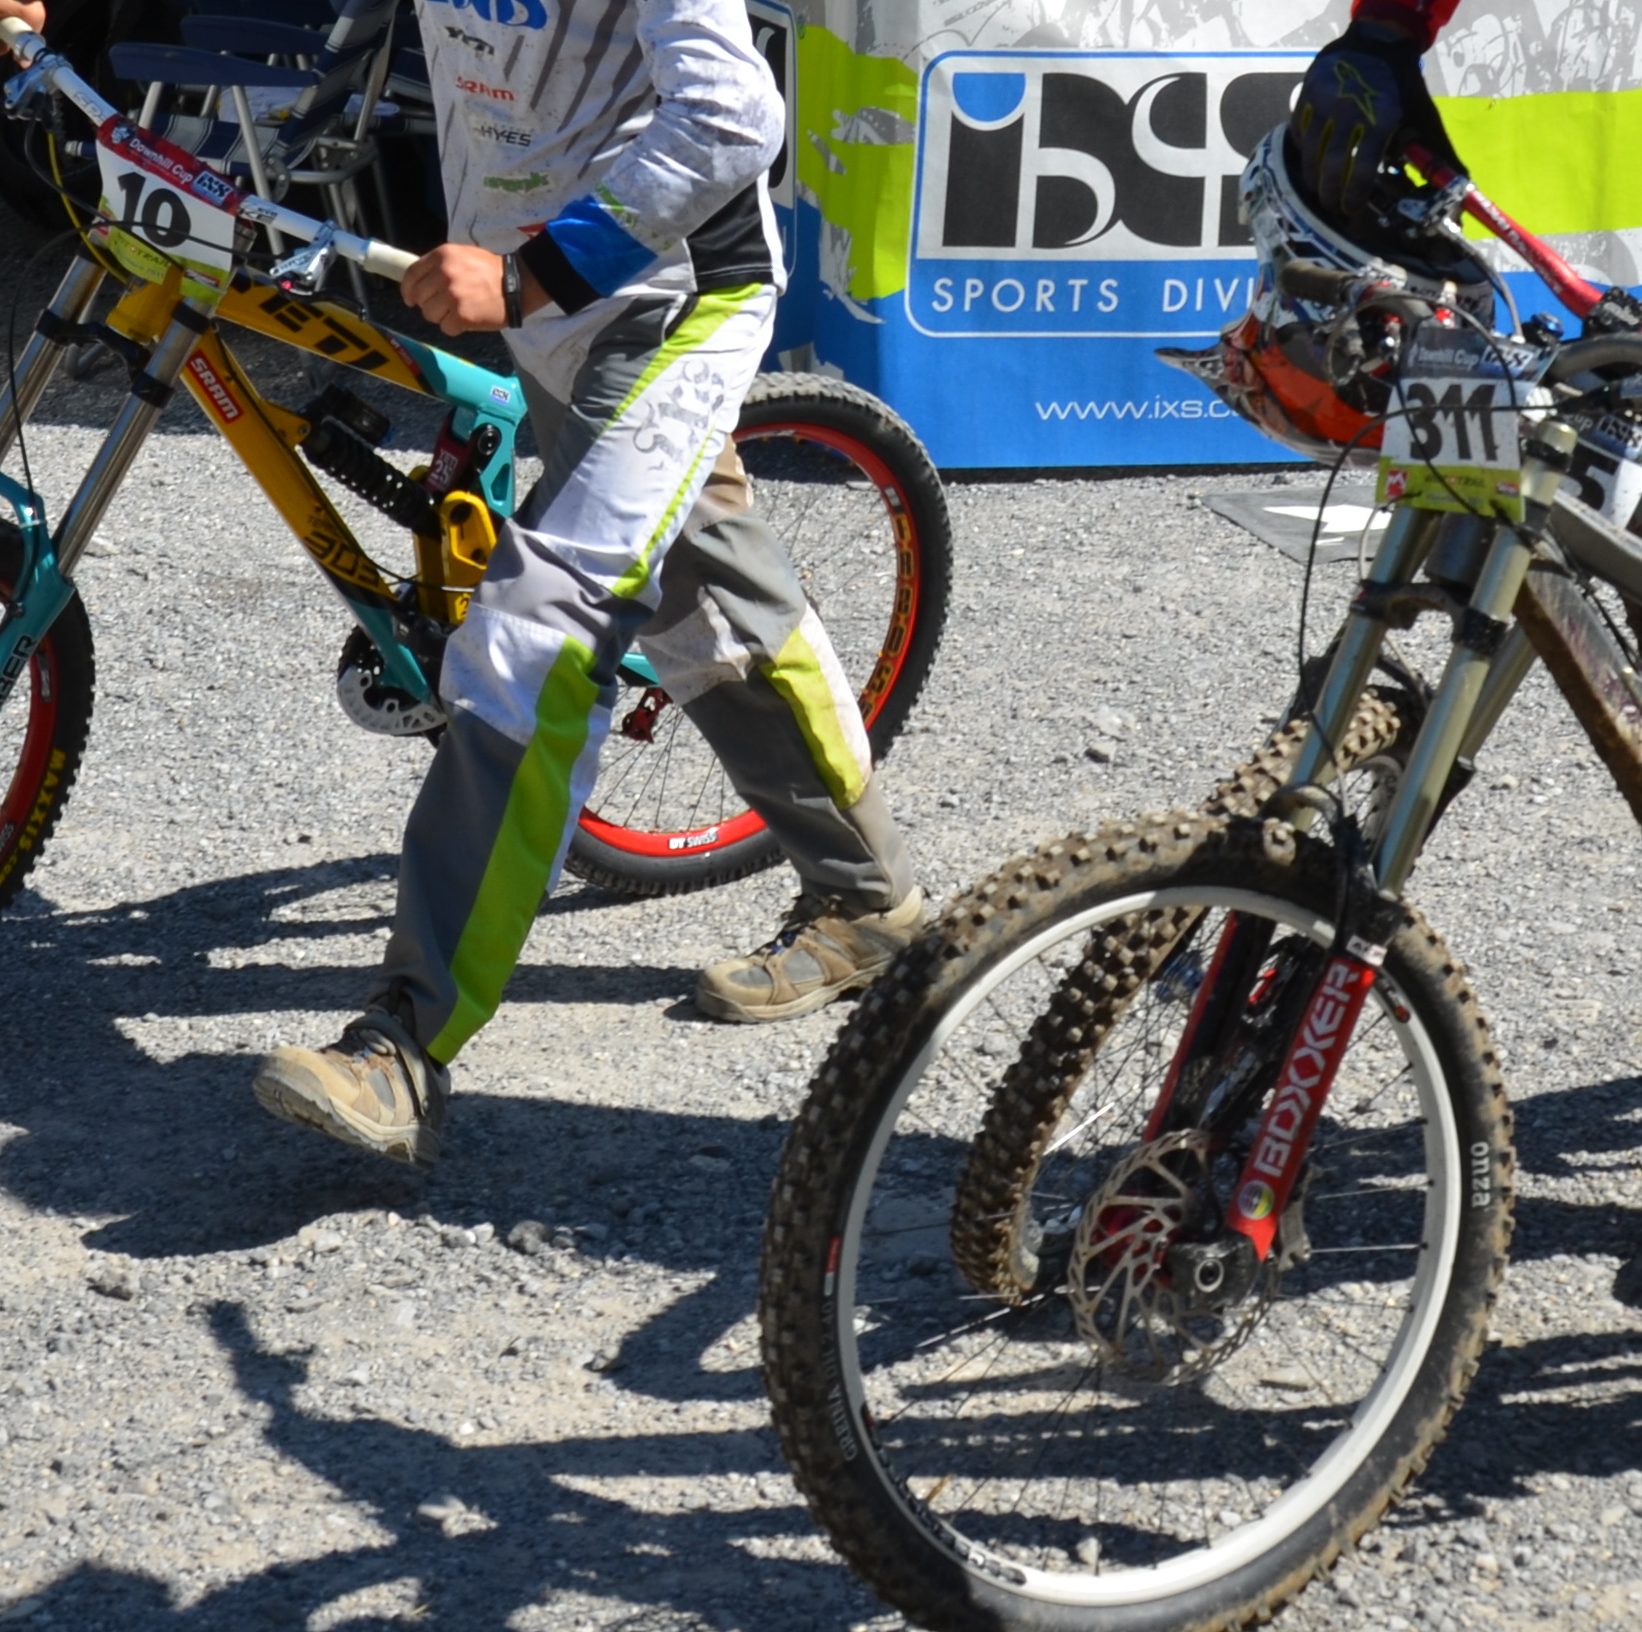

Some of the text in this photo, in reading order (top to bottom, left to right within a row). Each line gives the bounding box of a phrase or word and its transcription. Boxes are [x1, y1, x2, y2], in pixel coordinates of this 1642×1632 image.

[129, 137, 174, 170] Downhill
[172, 163, 194, 185] Cup
[117, 172, 191, 249] 10
[931, 277, 1255, 313] SPORTS DIVI
[189, 355, 239, 422] SRAM
[1455, 349, 1479, 370] Cup
[1035, 395, 1240, 419] www.ixs.c
[1407, 382, 1498, 463] 311
[1470, 1141, 1489, 1209] onza
[828, 1383, 856, 1460] GREINA
